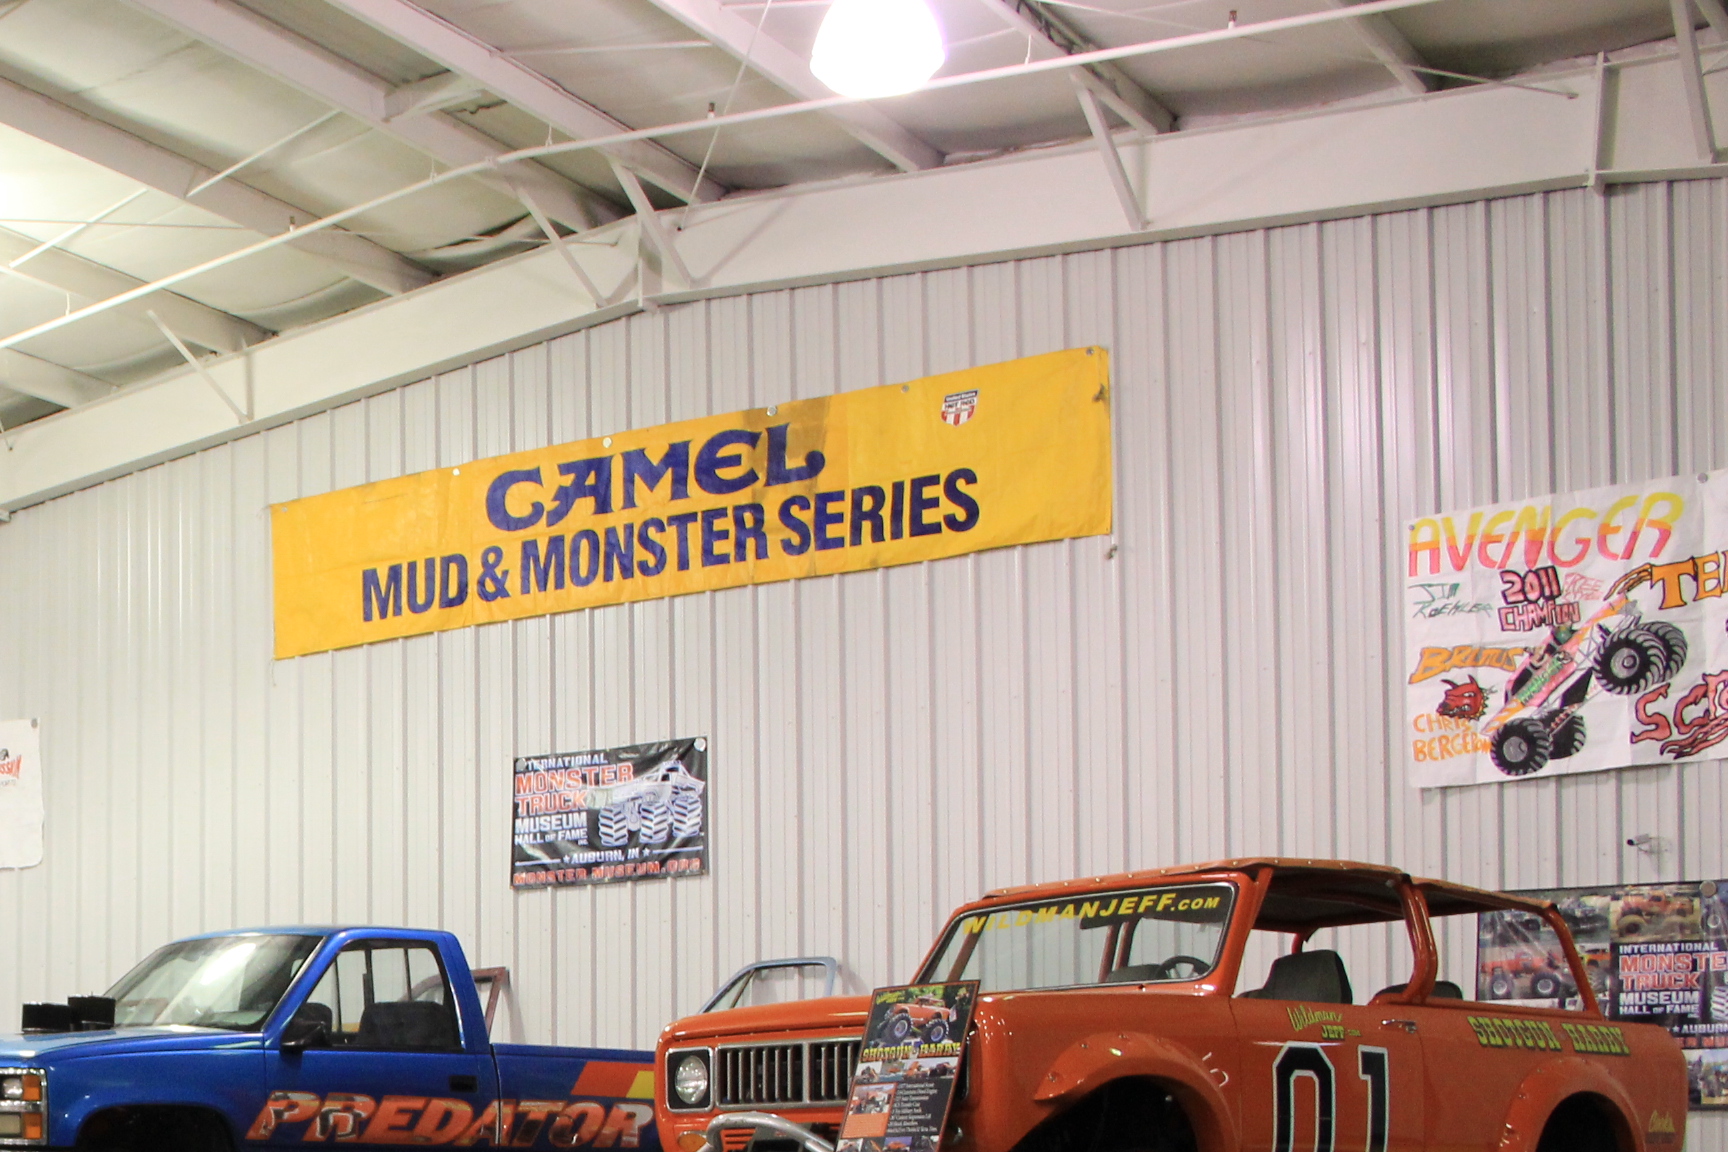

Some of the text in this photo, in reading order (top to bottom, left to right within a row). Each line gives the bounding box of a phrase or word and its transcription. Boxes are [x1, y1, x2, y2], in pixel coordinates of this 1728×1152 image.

[485, 422, 826, 531] CAMEL
[361, 467, 980, 622] MUD & MONSTER SERIES
[1408, 492, 1684, 577] AVENGER
[1500, 565, 1562, 604] 2011
[1498, 599, 1581, 631] CHAMPION
[516, 753, 608, 771] TERNATIONAL
[515, 763, 634, 795] MONSTER
[515, 789, 588, 816] TRUCK
[515, 812, 587, 834] MUSEUM
[514, 832, 544, 845] HALL
[558, 828, 588, 841] FAME
[628, 848, 640, 859] IN
[513, 868, 587, 885] MONSTER
[1619, 942, 1718, 954] INTERNATIONAL
[1618, 951, 1728, 974] MONSTE
[1619, 972, 1701, 991] TRUCK
[1619, 990, 1699, 1005] MUSEUM
[1619, 1005, 1651, 1015] HALL
[1666, 1004, 1700, 1014] FAME
[1467, 1016, 1562, 1052] SHOTGUN
[246, 1091, 653, 1148] PREDATOR
